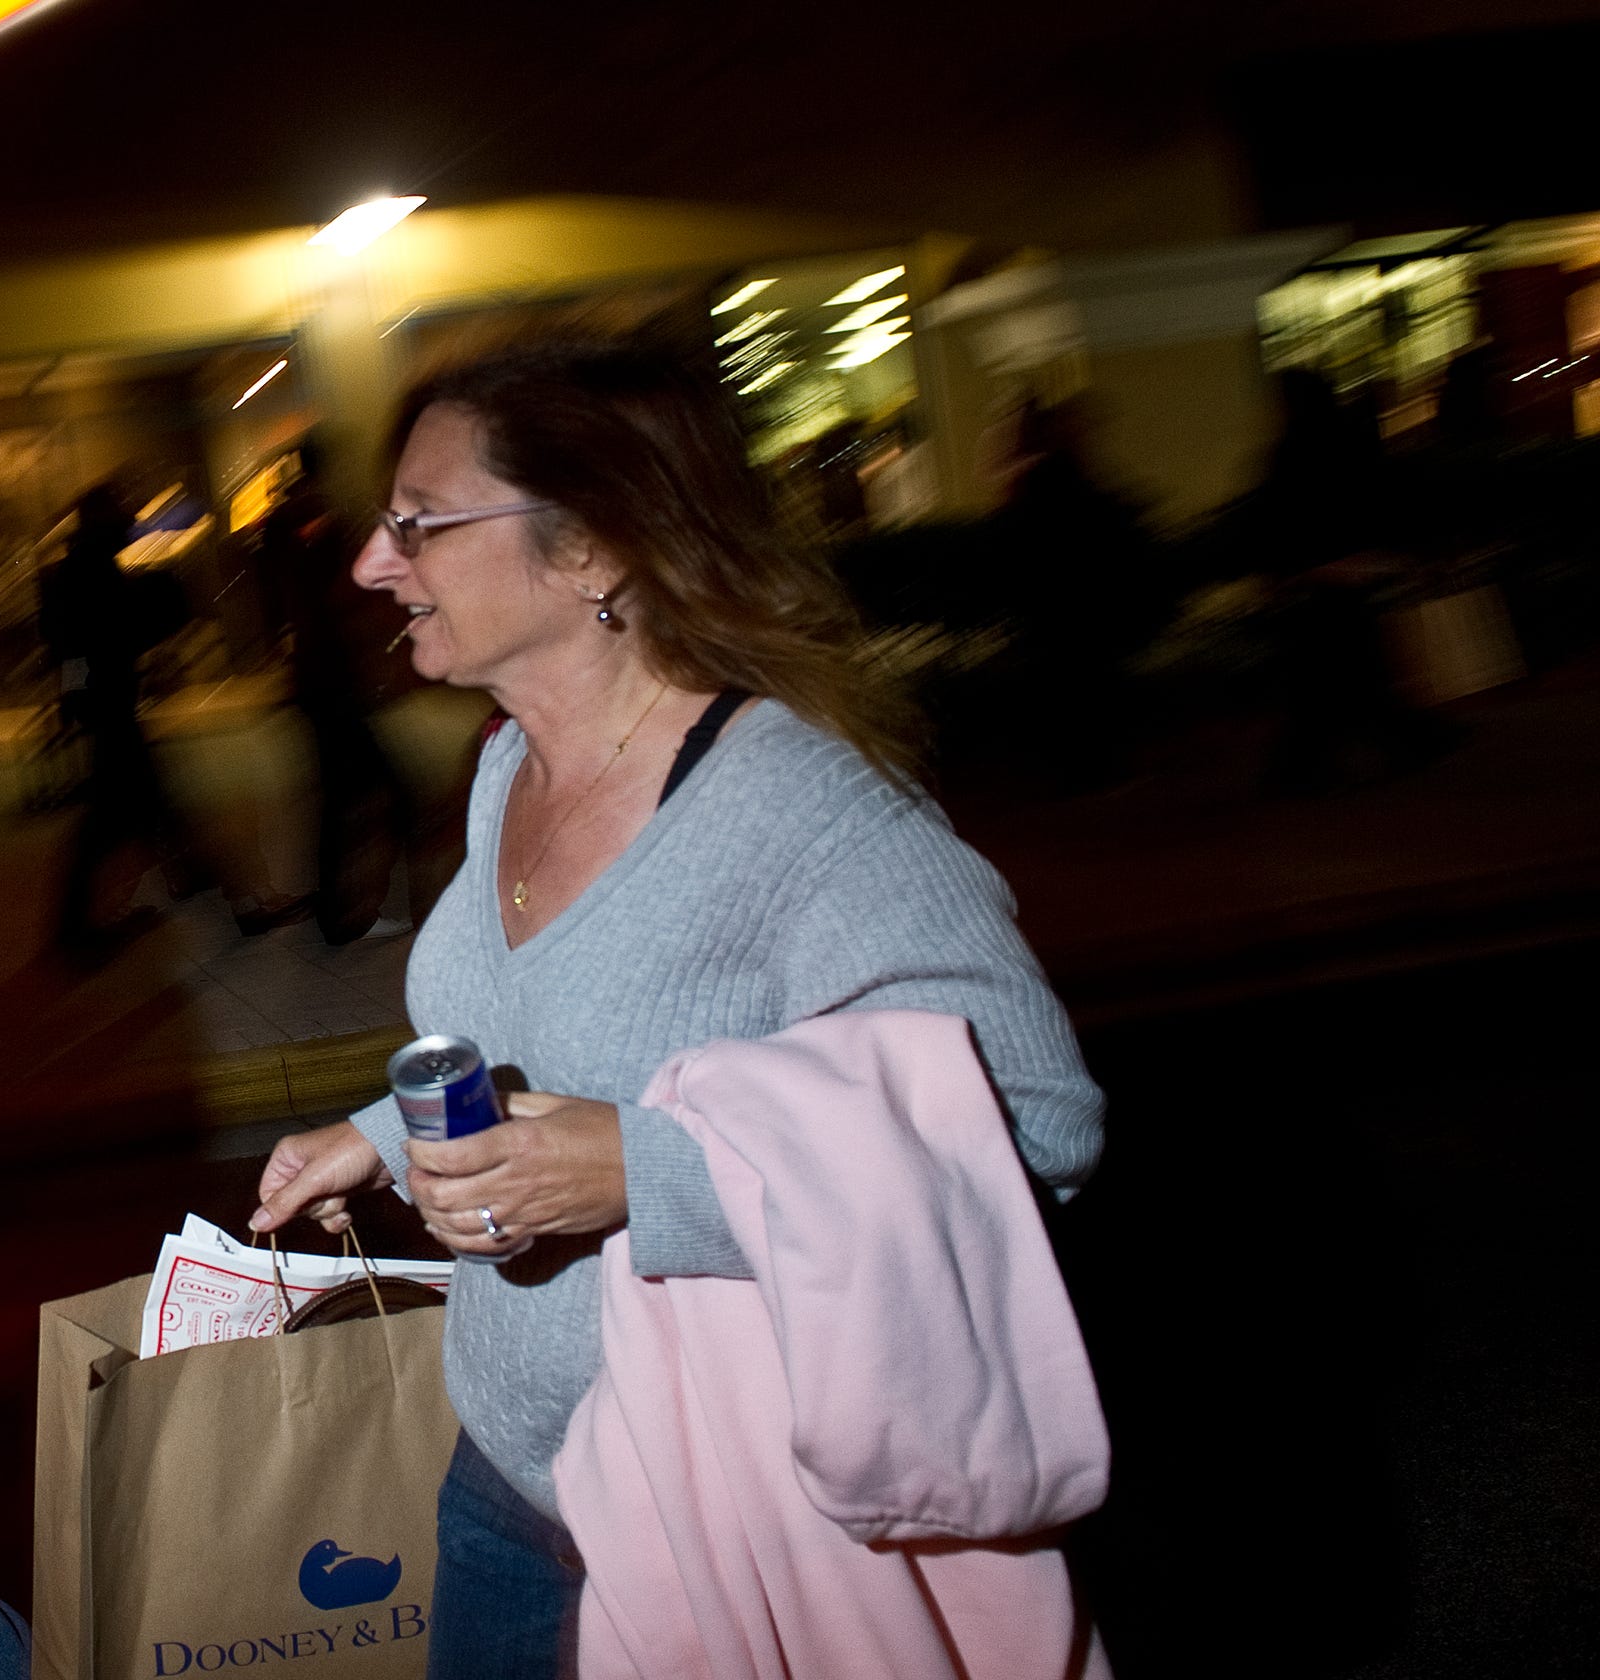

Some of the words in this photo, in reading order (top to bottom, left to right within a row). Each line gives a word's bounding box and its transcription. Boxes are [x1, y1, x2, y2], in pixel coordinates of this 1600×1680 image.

[180, 1281, 232, 1299] COACH
[152, 1625, 342, 1677] DOONEY
[351, 1619, 380, 1648] &
[389, 1603, 432, 1642] B
